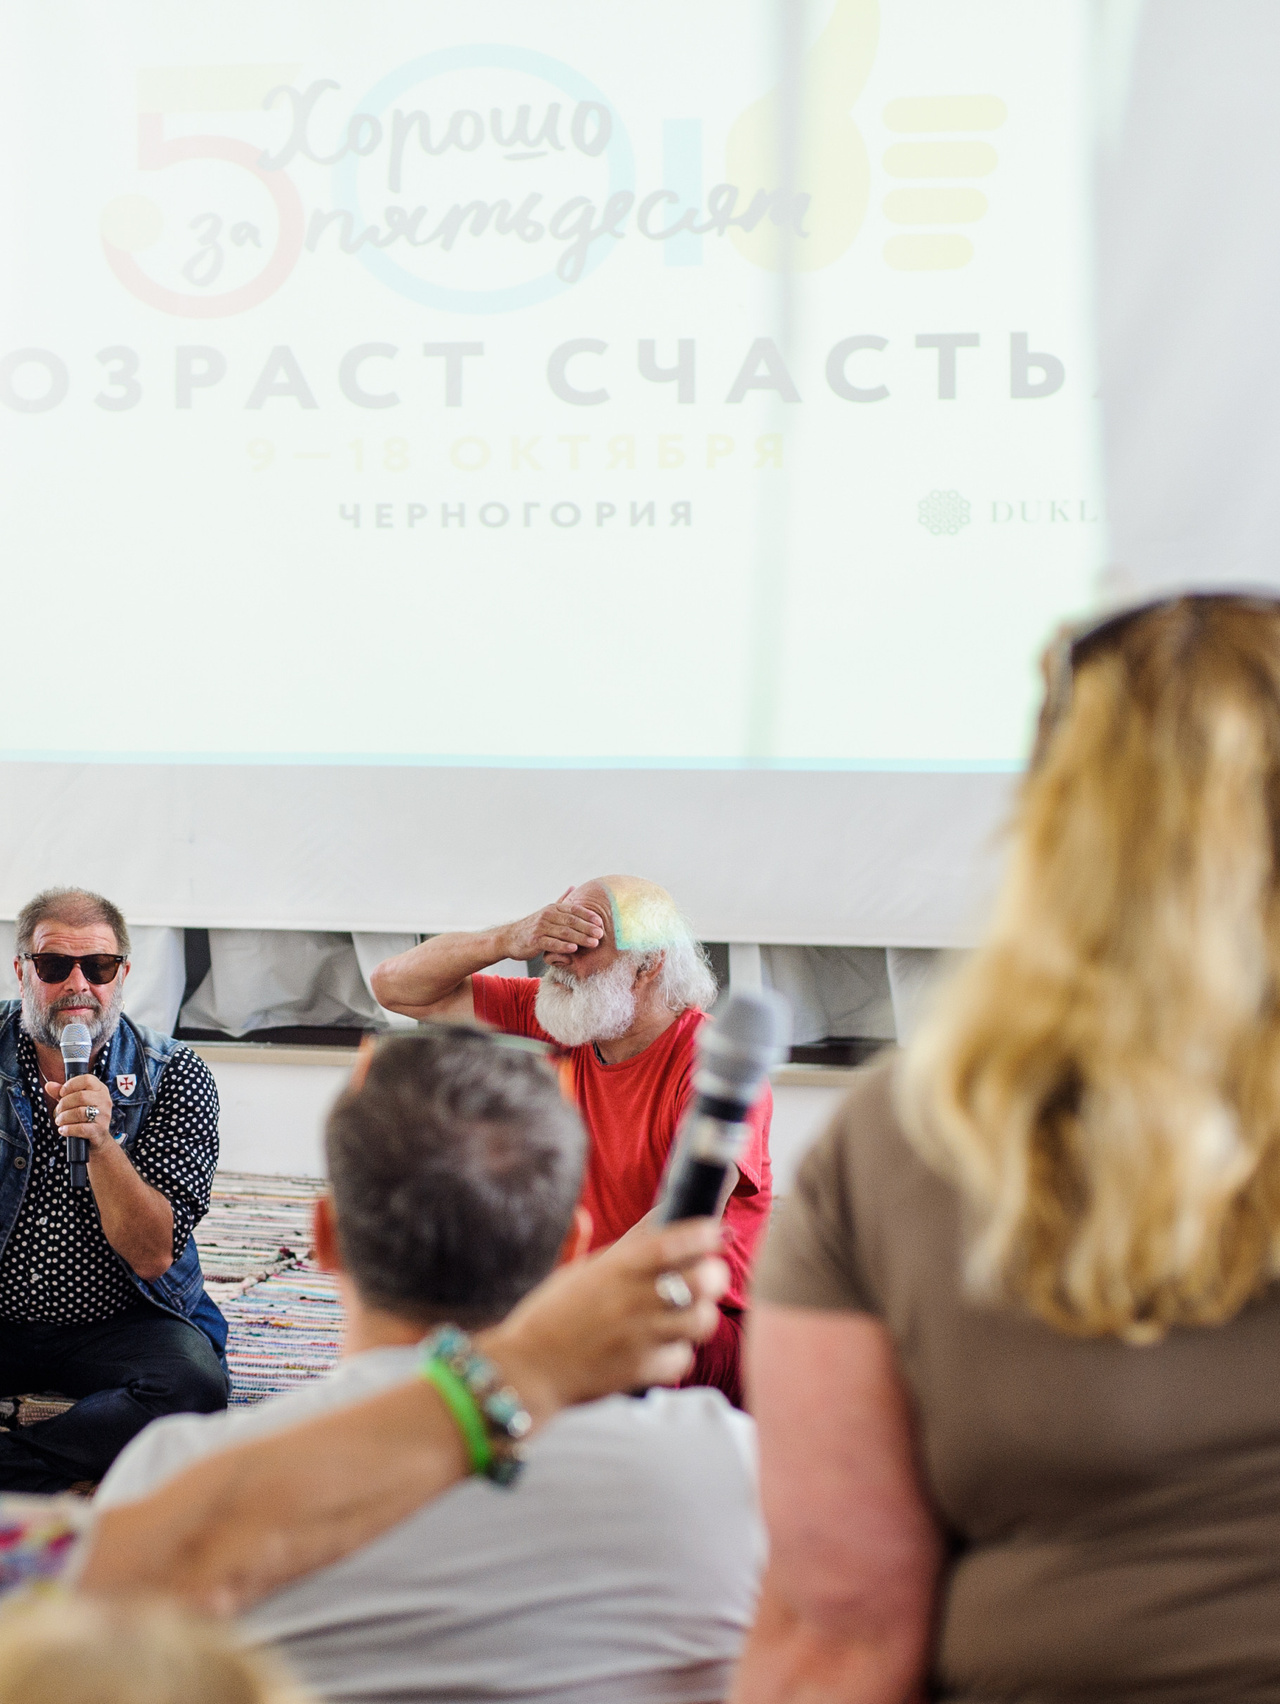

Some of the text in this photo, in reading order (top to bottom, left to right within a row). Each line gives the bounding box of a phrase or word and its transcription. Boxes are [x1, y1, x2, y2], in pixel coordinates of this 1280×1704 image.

[257, 79, 613, 194] Хорошо
[181, 182, 814, 287] за пятьдесят
[546, 331, 1104, 407] СЧАСТЬ
[448, 432, 786, 474] ОКТЯБРЯ
[337, 499, 695, 530] ЧЕРНОГОРИЯ
